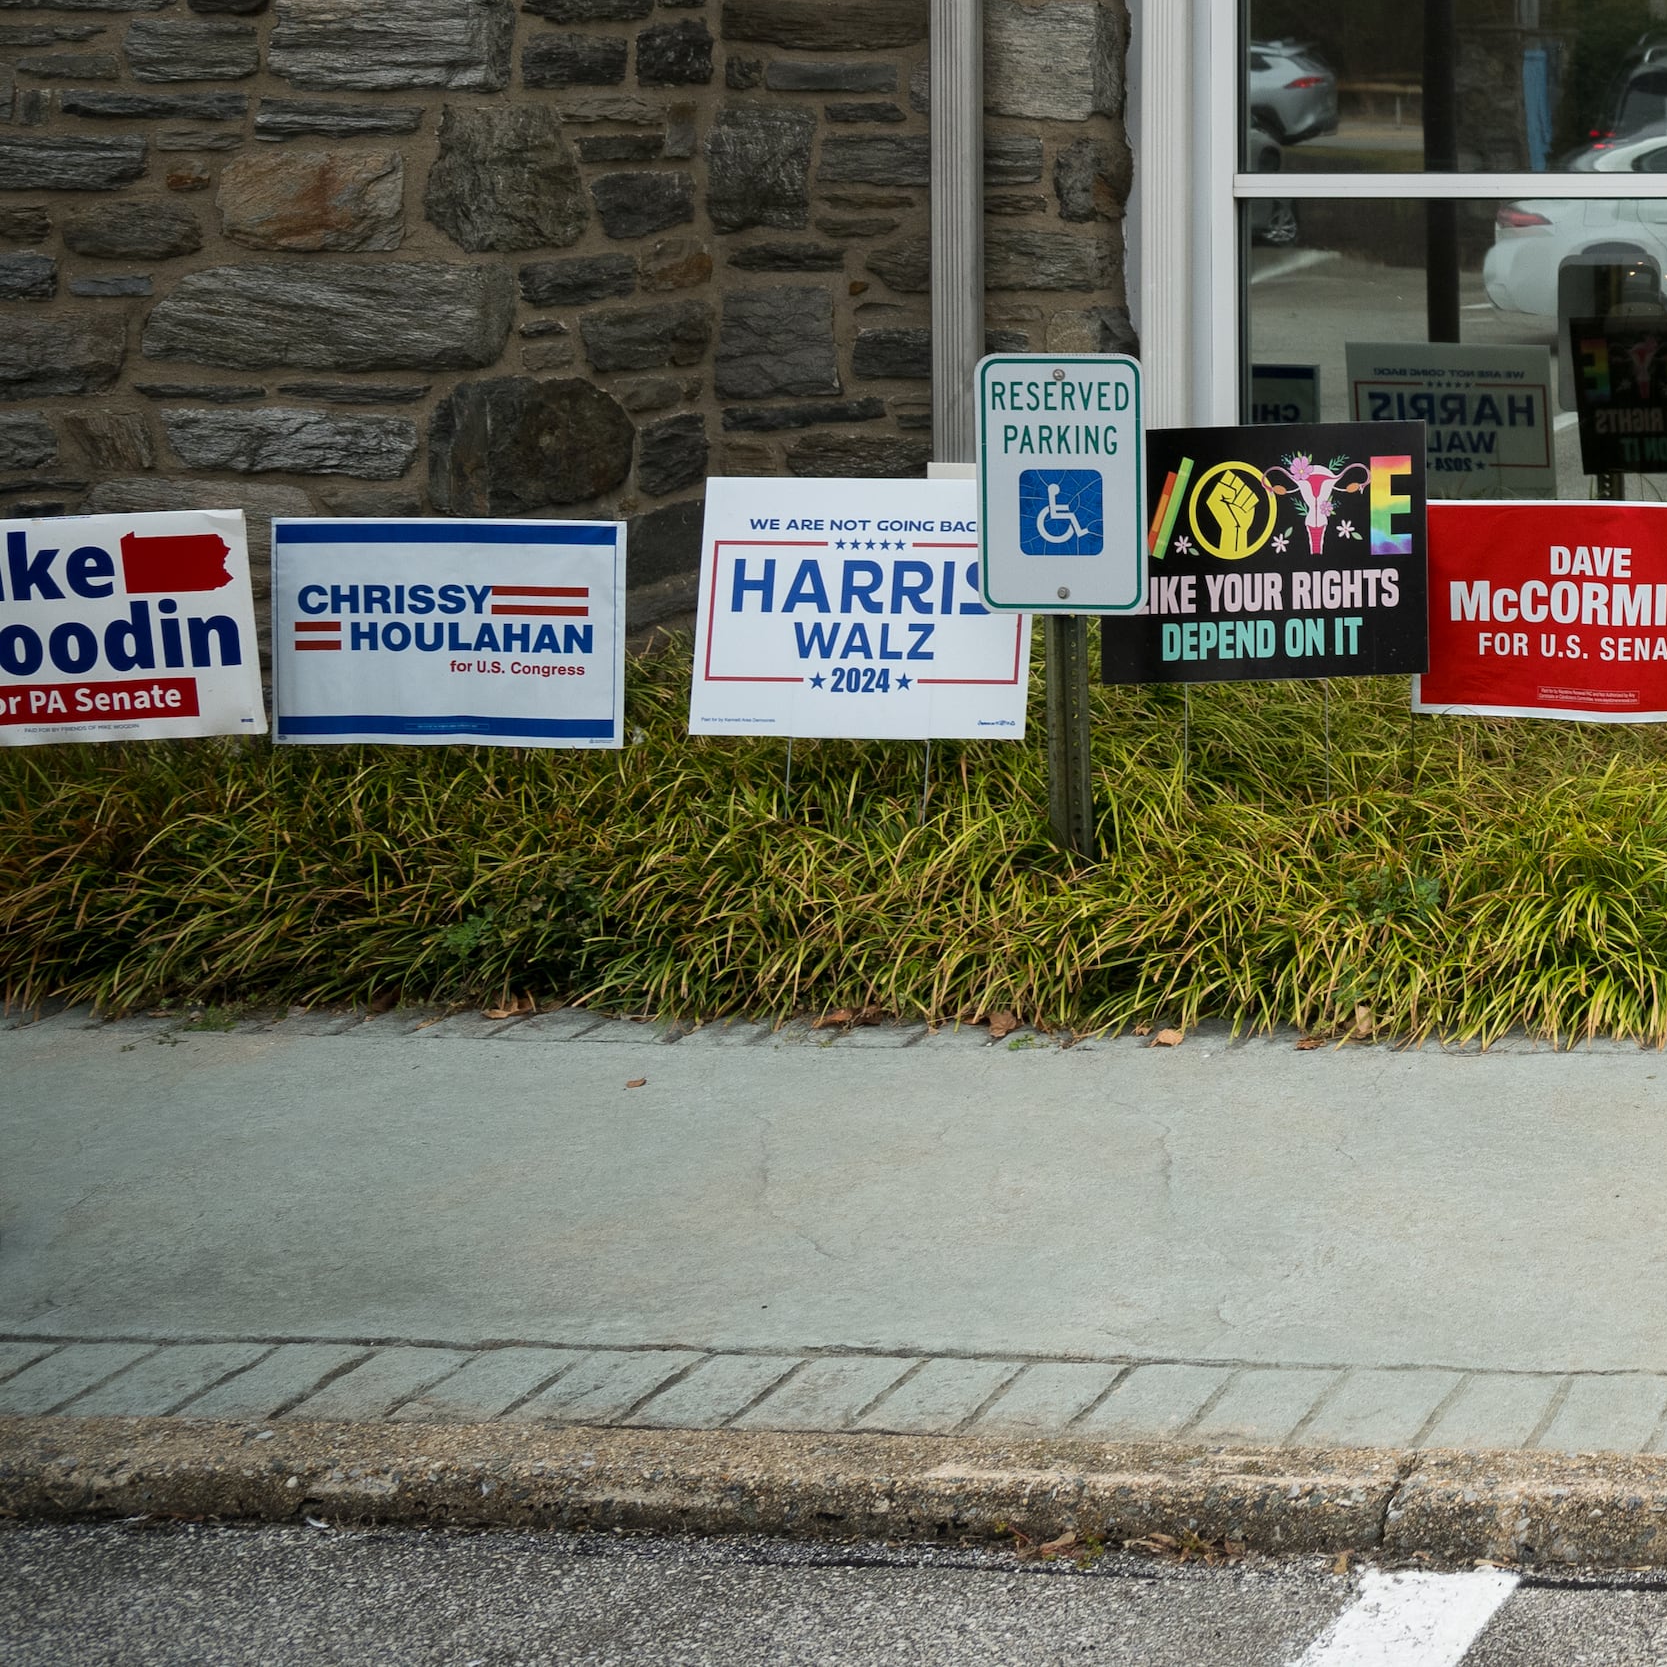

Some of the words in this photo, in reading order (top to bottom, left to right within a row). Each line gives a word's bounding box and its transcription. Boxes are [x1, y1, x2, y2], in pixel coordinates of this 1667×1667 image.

[991, 381, 1130, 411] RESERVED
[1003, 425, 1118, 455] PARKING
[749, 518, 780, 530] WE
[785, 518, 825, 531] ARE
[829, 519, 872, 531] NOT
[876, 519, 935, 532] GOING
[940, 520, 977, 532] BAC
[0, 531, 115, 601] ke
[1550, 545, 1632, 578] DAVE
[297, 584, 493, 615] CHRISSY
[1141, 575, 1197, 615] IKE
[1205, 572, 1284, 613] YOUR
[1292, 568, 1400, 610] RIGHTS
[0, 598, 242, 676] oodin
[350, 621, 593, 654] HOULAHAN
[794, 622, 935, 660] WALZ
[1162, 620, 1276, 662] DEPEND
[1284, 617, 1325, 657] ON
[1334, 617, 1363, 656] IT
[1478, 632, 1529, 656] FOR
[1540, 634, 1588, 659] U.S.
[450, 660, 473, 673] for
[477, 661, 504, 674] U.S.
[510, 661, 585, 677] Congress
[830, 667, 890, 692] 2024
[0, 695, 22, 715] or
[30, 691, 67, 714] PA
[76, 684, 182, 712] Senate
